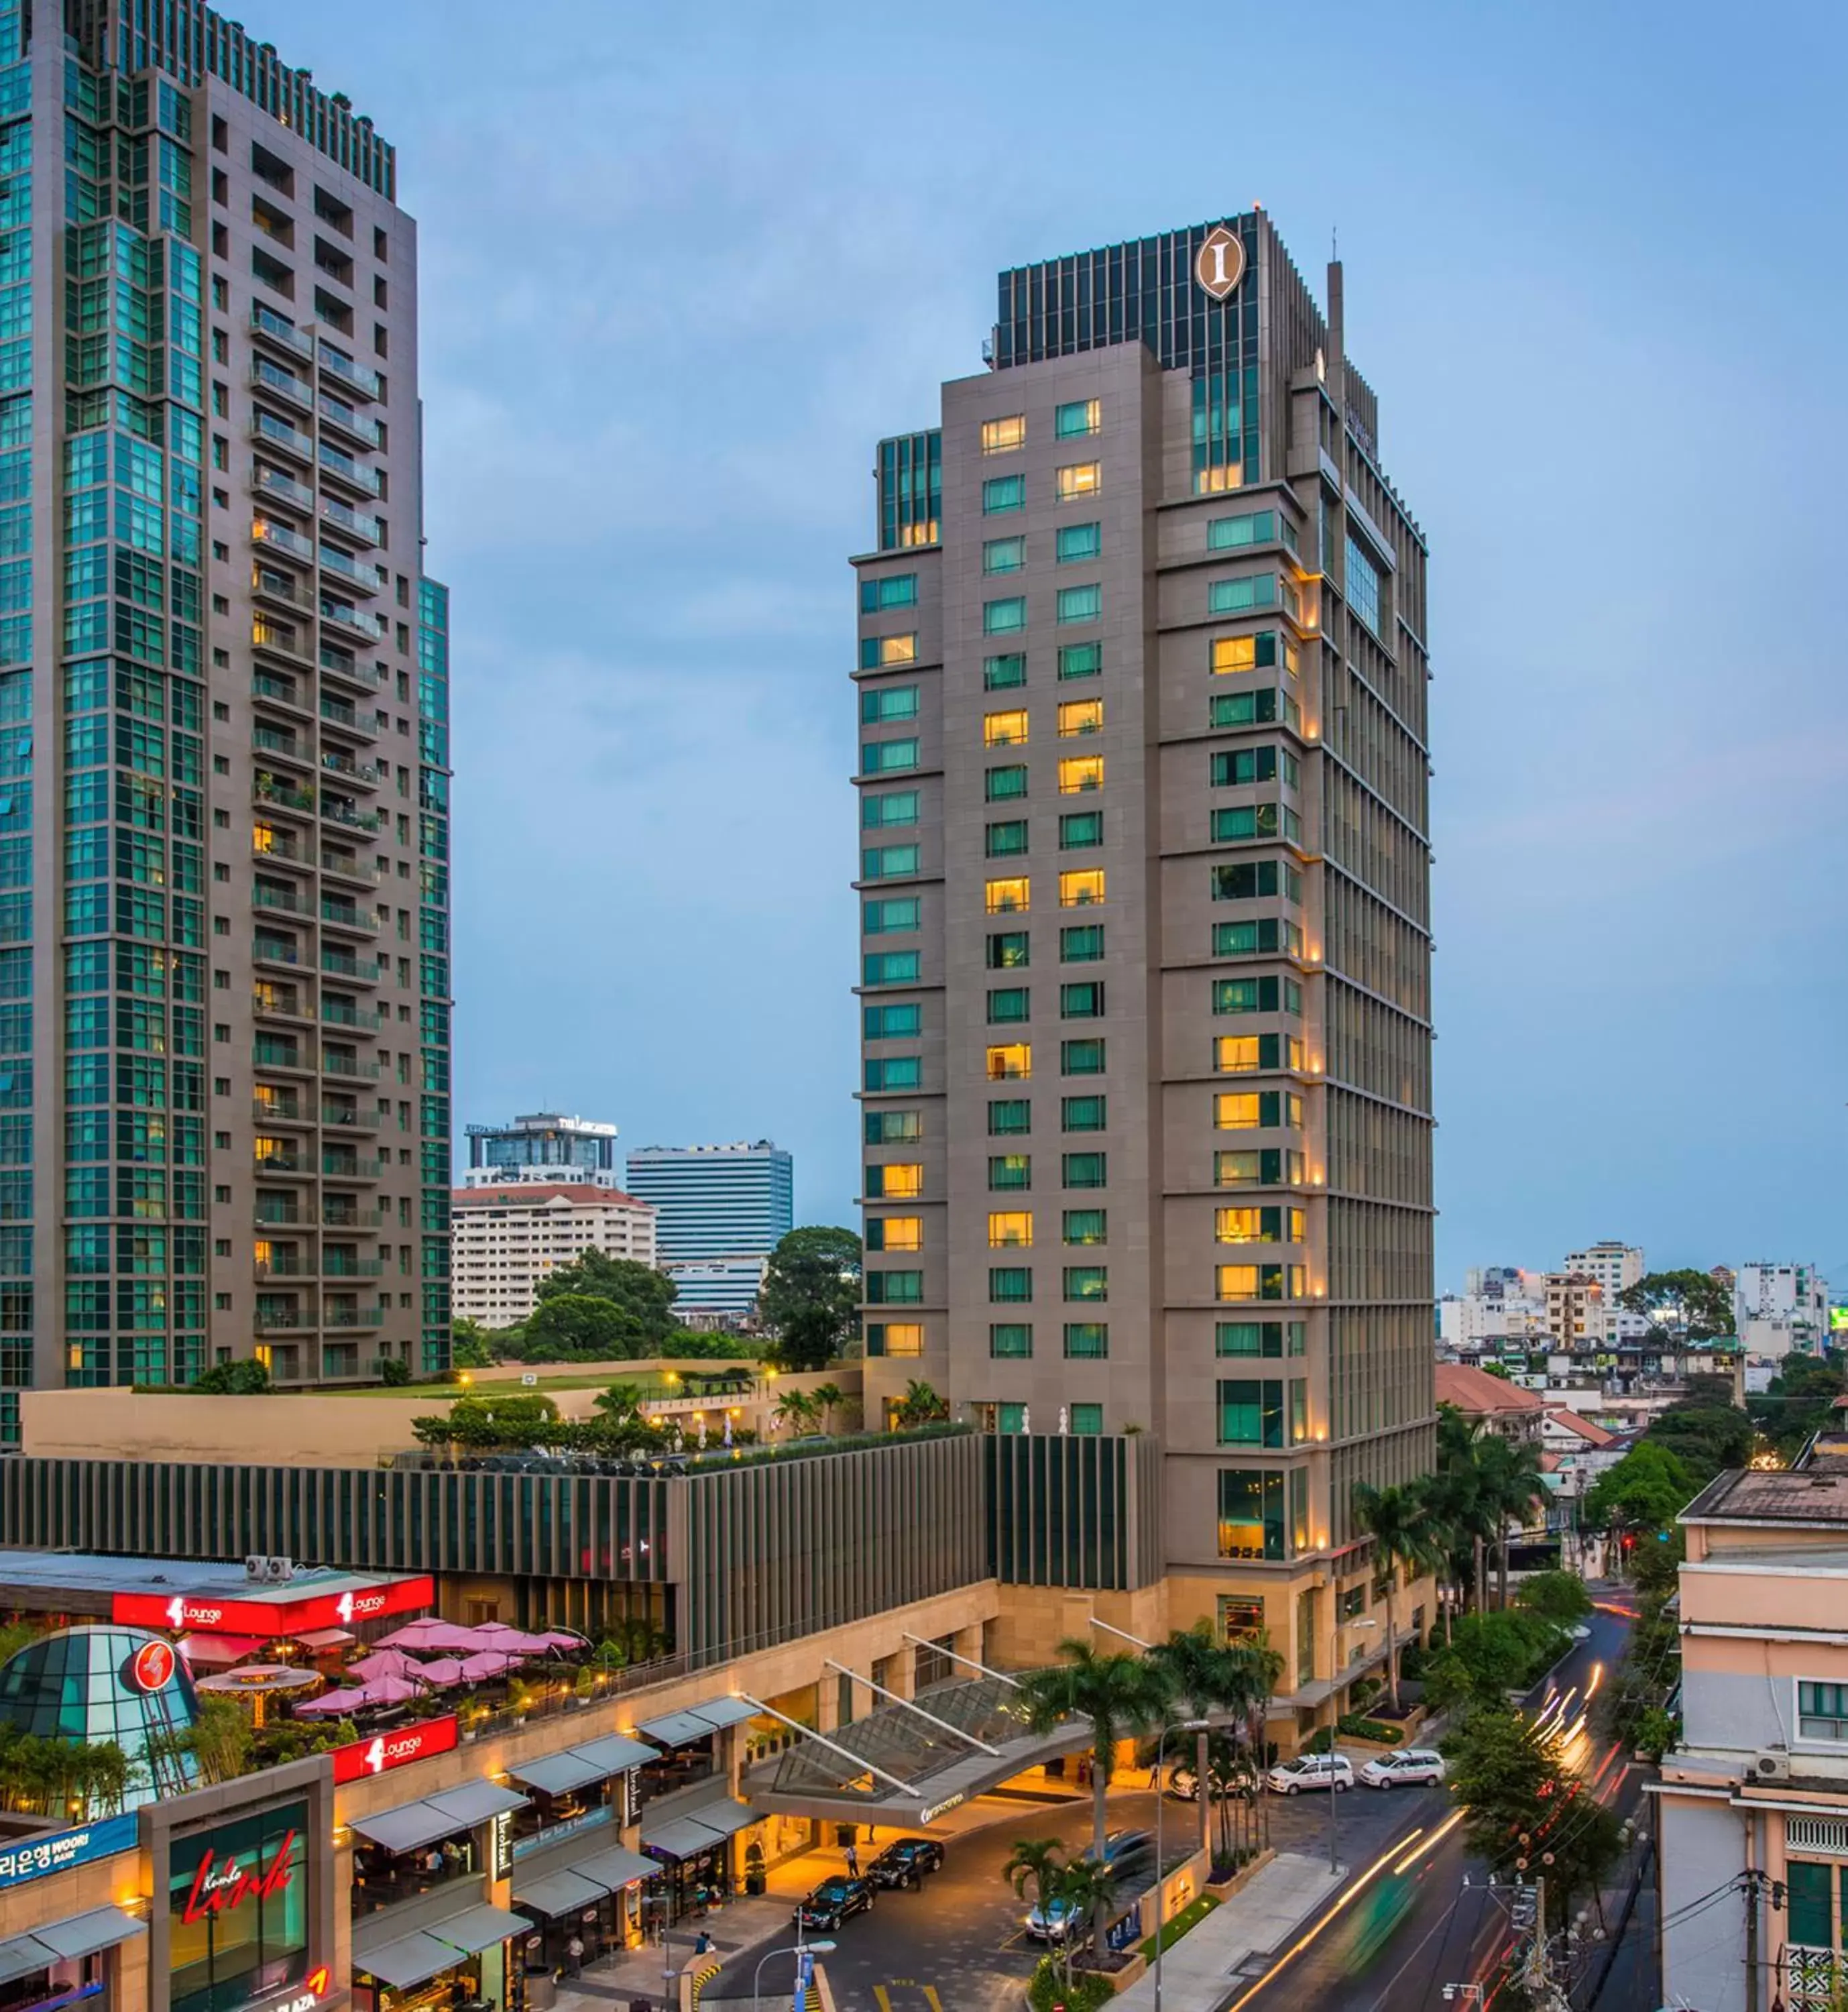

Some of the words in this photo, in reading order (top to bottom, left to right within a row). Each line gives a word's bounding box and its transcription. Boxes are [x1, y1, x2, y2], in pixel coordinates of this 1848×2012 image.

[1209, 241, 1231, 285] I
[183, 1605, 222, 1624] Lounge
[52, 1833, 90, 1855] WOORI
